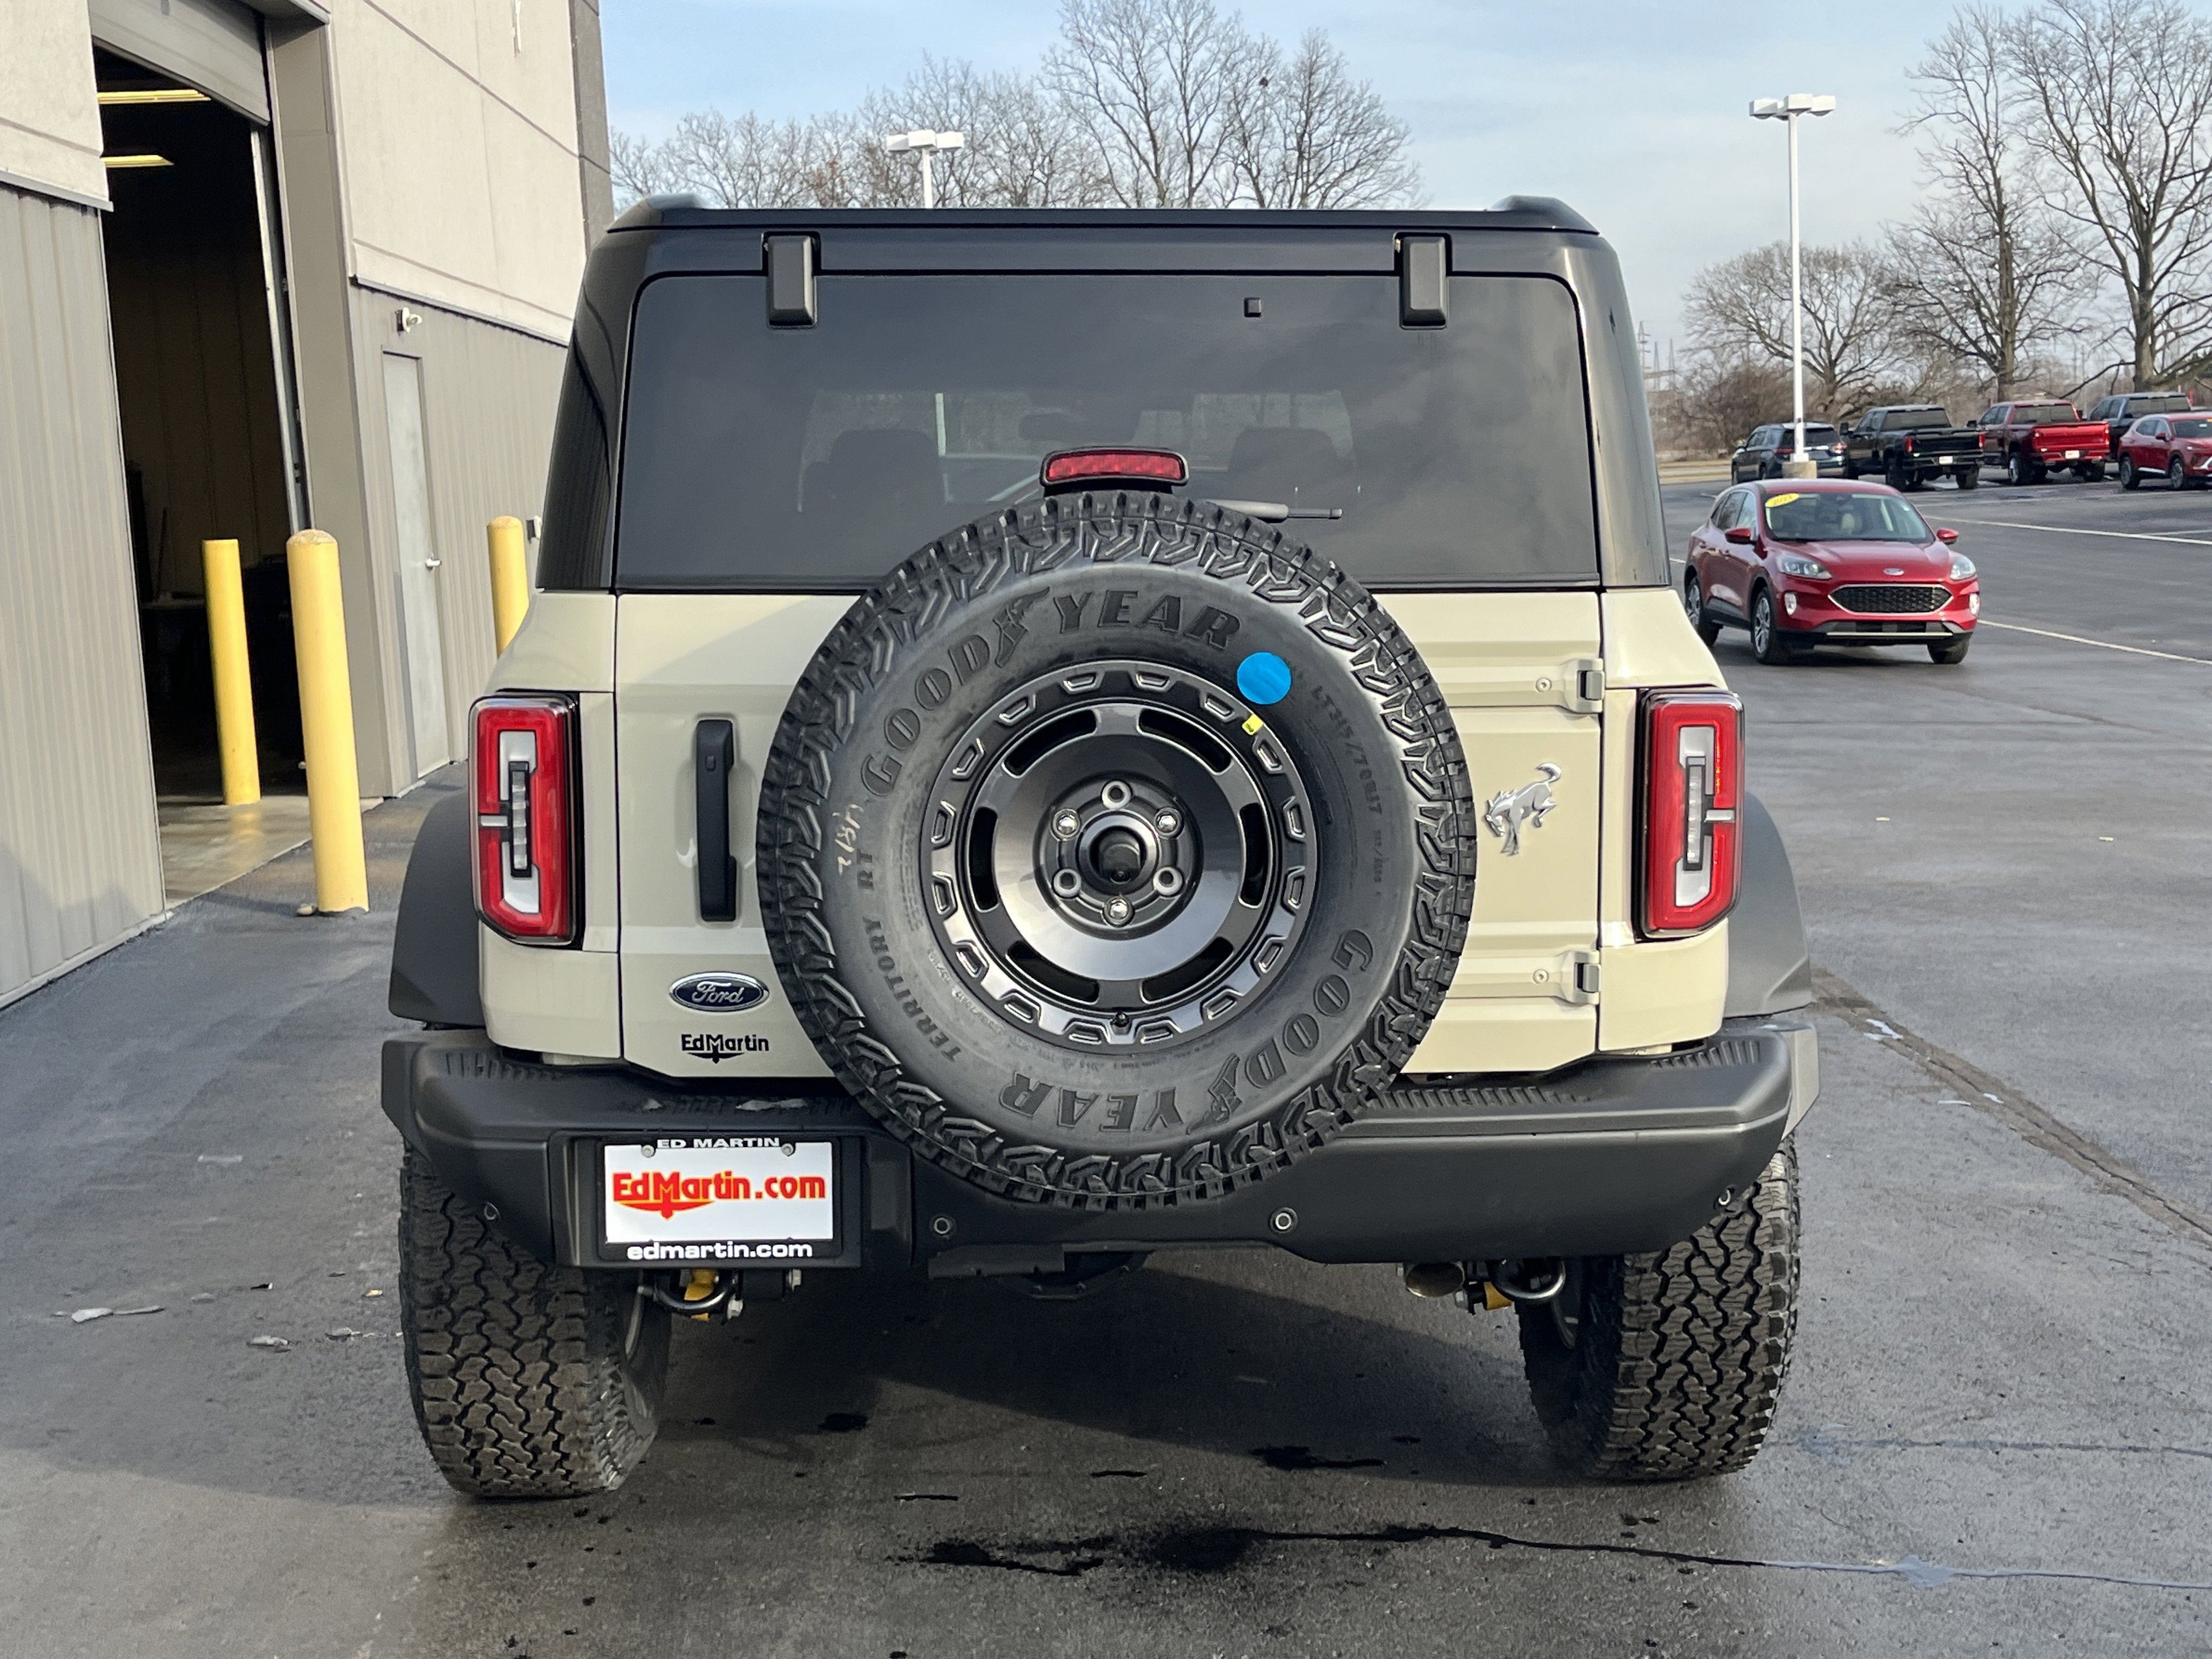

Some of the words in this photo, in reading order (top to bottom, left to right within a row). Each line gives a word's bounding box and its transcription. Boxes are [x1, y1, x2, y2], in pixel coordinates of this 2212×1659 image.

[856, 847, 874, 891] RT
[692, 981, 745, 1005] Ford
[862, 916, 962, 1062] TERRITORY
[681, 1034, 769, 1052] EdMartin
[657, 1139, 687, 1148] ED
[693, 1137, 780, 1148] MARTIN
[627, 1242, 812, 1260] edmartin.com
